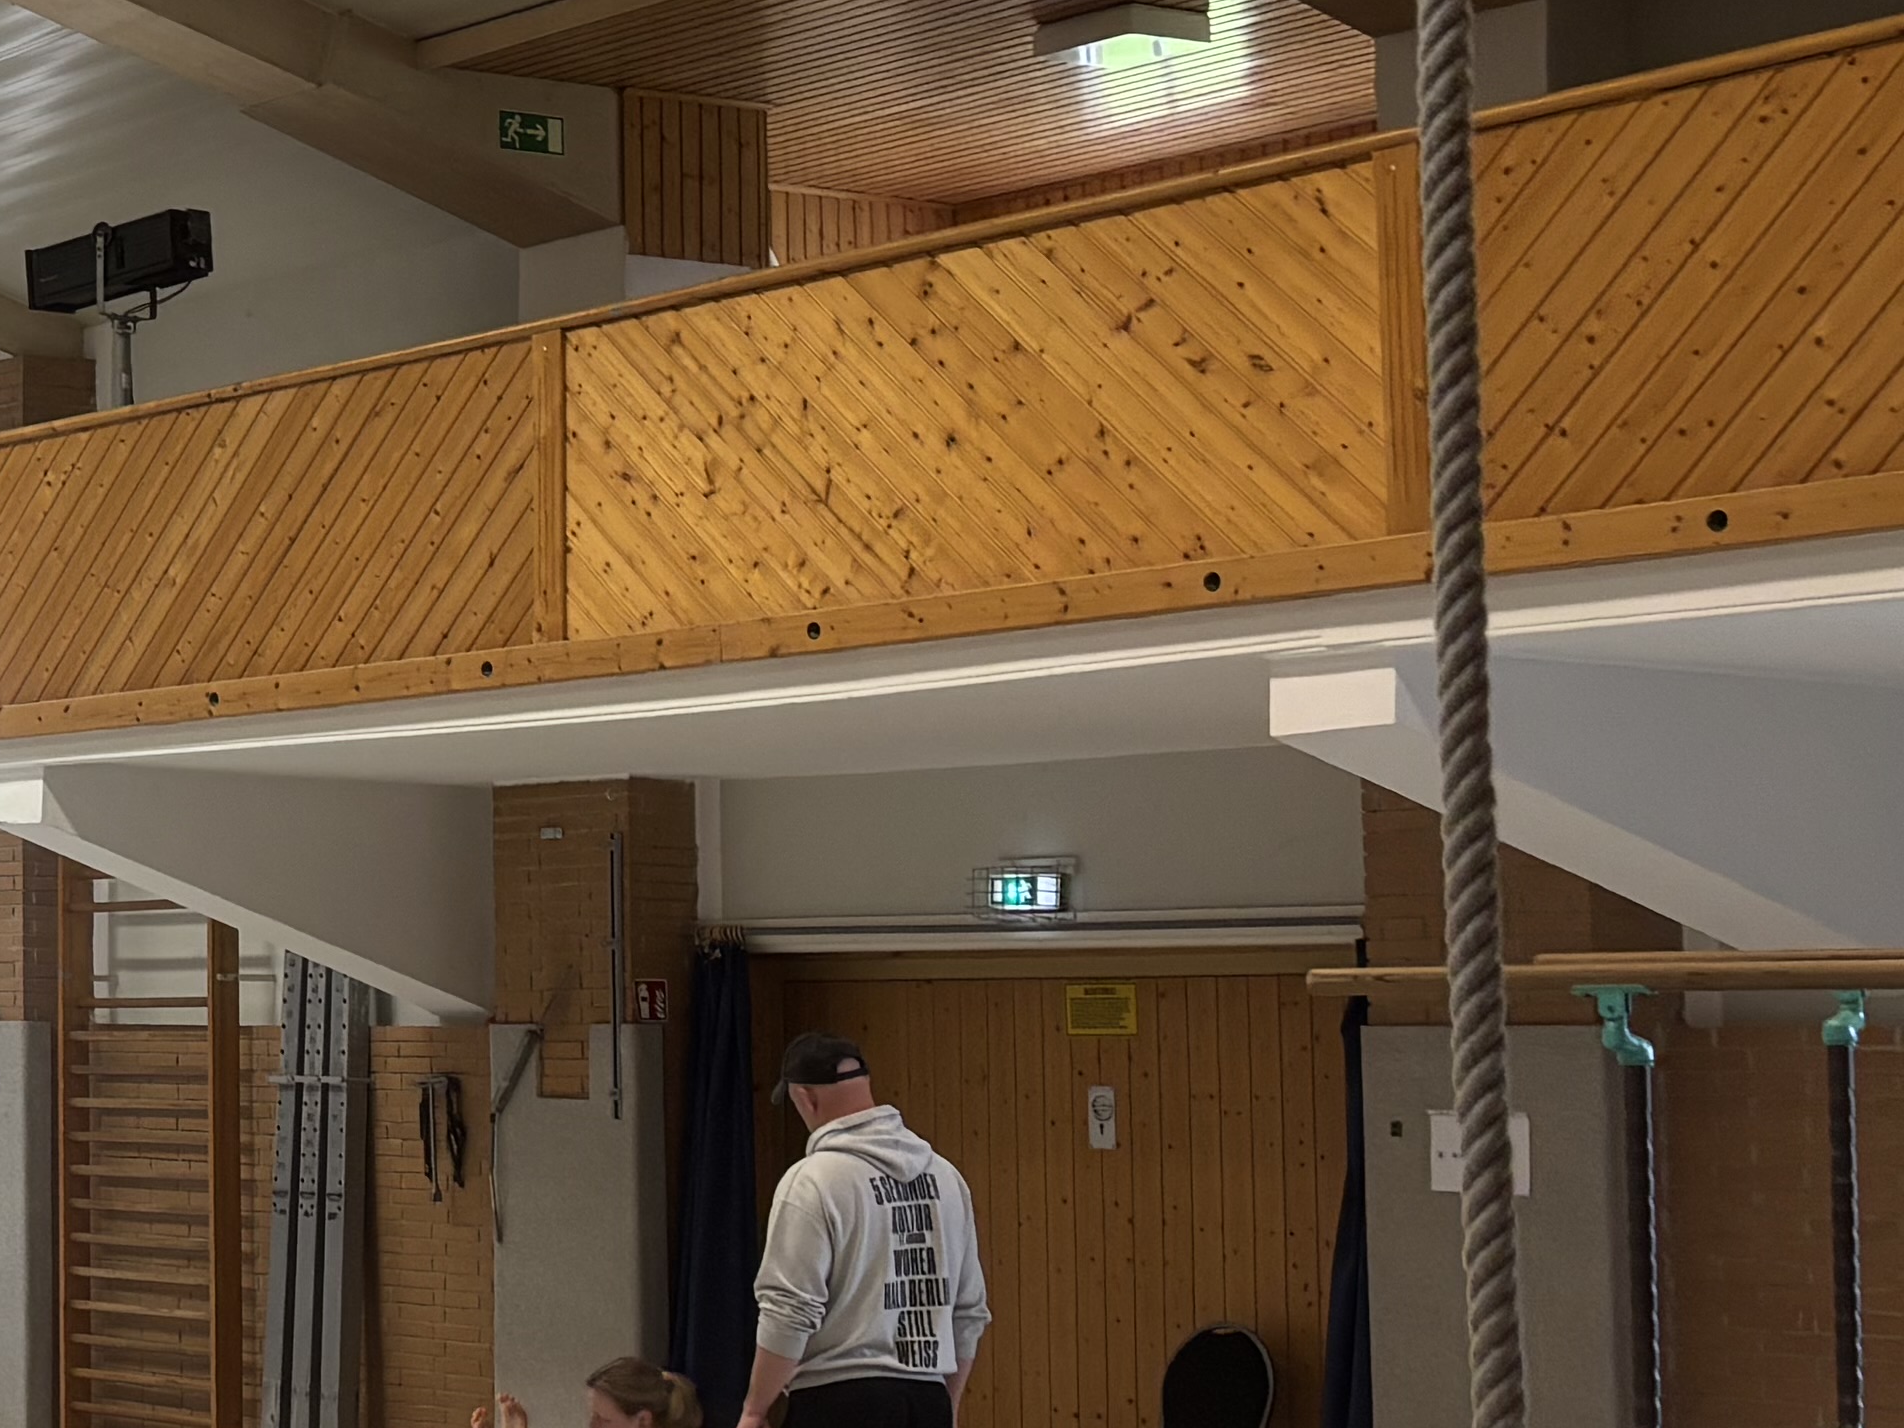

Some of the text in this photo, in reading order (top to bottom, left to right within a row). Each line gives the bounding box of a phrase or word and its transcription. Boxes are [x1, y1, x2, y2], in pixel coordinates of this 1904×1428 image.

[869, 1177, 884, 1205] 5
[891, 1203, 934, 1234] KULTUR
[893, 1247, 937, 1277] WOHER
[897, 1309, 936, 1338] STILL
[895, 1340, 939, 1369] WEISS
